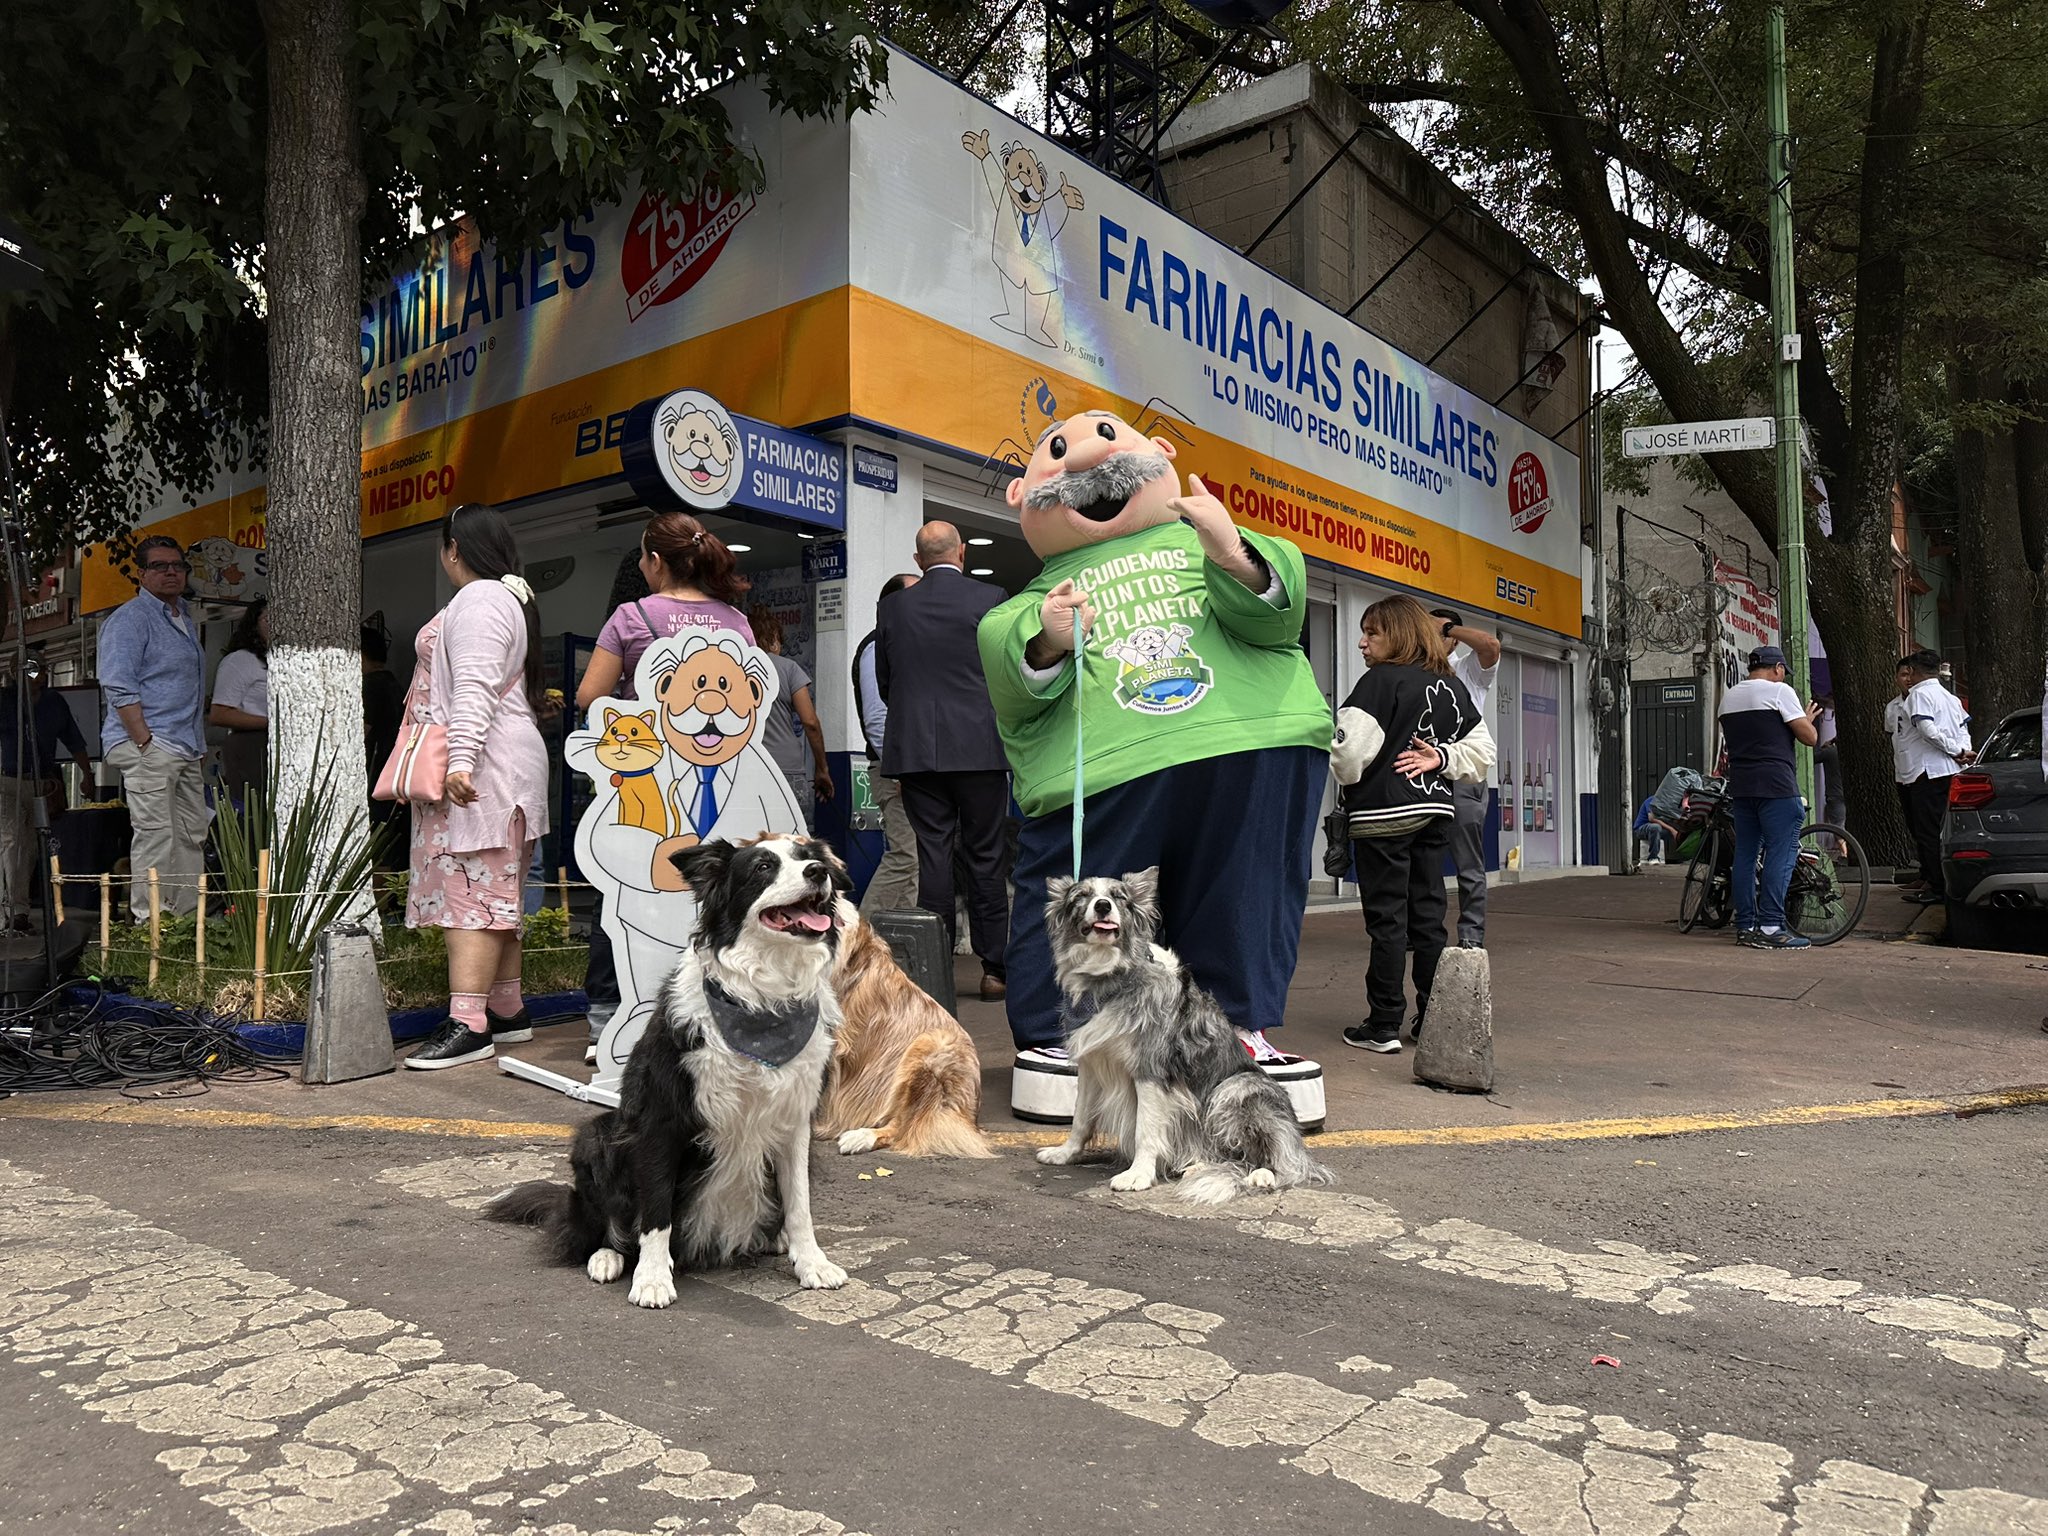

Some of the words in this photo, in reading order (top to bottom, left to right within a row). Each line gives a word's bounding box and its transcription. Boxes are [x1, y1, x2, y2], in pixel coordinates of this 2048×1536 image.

[638, 278, 662, 307] DE
[672, 202, 742, 276] AHORRO
[359, 203, 596, 378] SIMILARES
[1063, 339, 1077, 357] Dr.
[1079, 347, 1097, 364] Simi
[1099, 214, 1342, 412] FARMACIAS
[1353, 358, 1498, 488] SIMILARES
[1244, 384, 1303, 434] MISMO
[1307, 413, 1351, 456] PERO
[1355, 434, 1387, 471] MAS
[1645, 429, 1689, 450] JOSÉ
[1694, 424, 1746, 446] MARTÍ
[379, 463, 389, 475] su
[747, 433, 839, 483] FARMACIAS
[858, 461, 894, 481] PROSPERIDAD
[1515, 456, 1533, 471] HASTA
[369, 464, 456, 517] MEDICO
[752, 469, 837, 515] SIMILARES
[1250, 467, 1266, 482] Para
[1267, 476, 1289, 491] ayudar
[1290, 487, 1296, 495] a
[1296, 486, 1306, 497] los
[1306, 491, 1319, 505] que
[1319, 496, 1339, 510] menos
[1360, 511, 1374, 523] pone
[1379, 517, 1386, 526] su
[1513, 467, 1542, 509] 75%
[1229, 483, 1366, 554] CONSULTORIO
[1371, 532, 1431, 575] MEDICO
[1514, 514, 1524, 527] DE
[1525, 503, 1548, 523] AHORRO
[1091, 574, 1181, 617] JUNTOS
[1496, 575, 1537, 609] BEST
[1104, 597, 1204, 637] PLANETA
[1131, 665, 1194, 689] PLANETA
[1664, 689, 1694, 699] ENTRADA
[1132, 699, 1162, 712] Cuidemos
[1162, 703, 1184, 713] juntos
[1189, 684, 1205, 703] planeta
